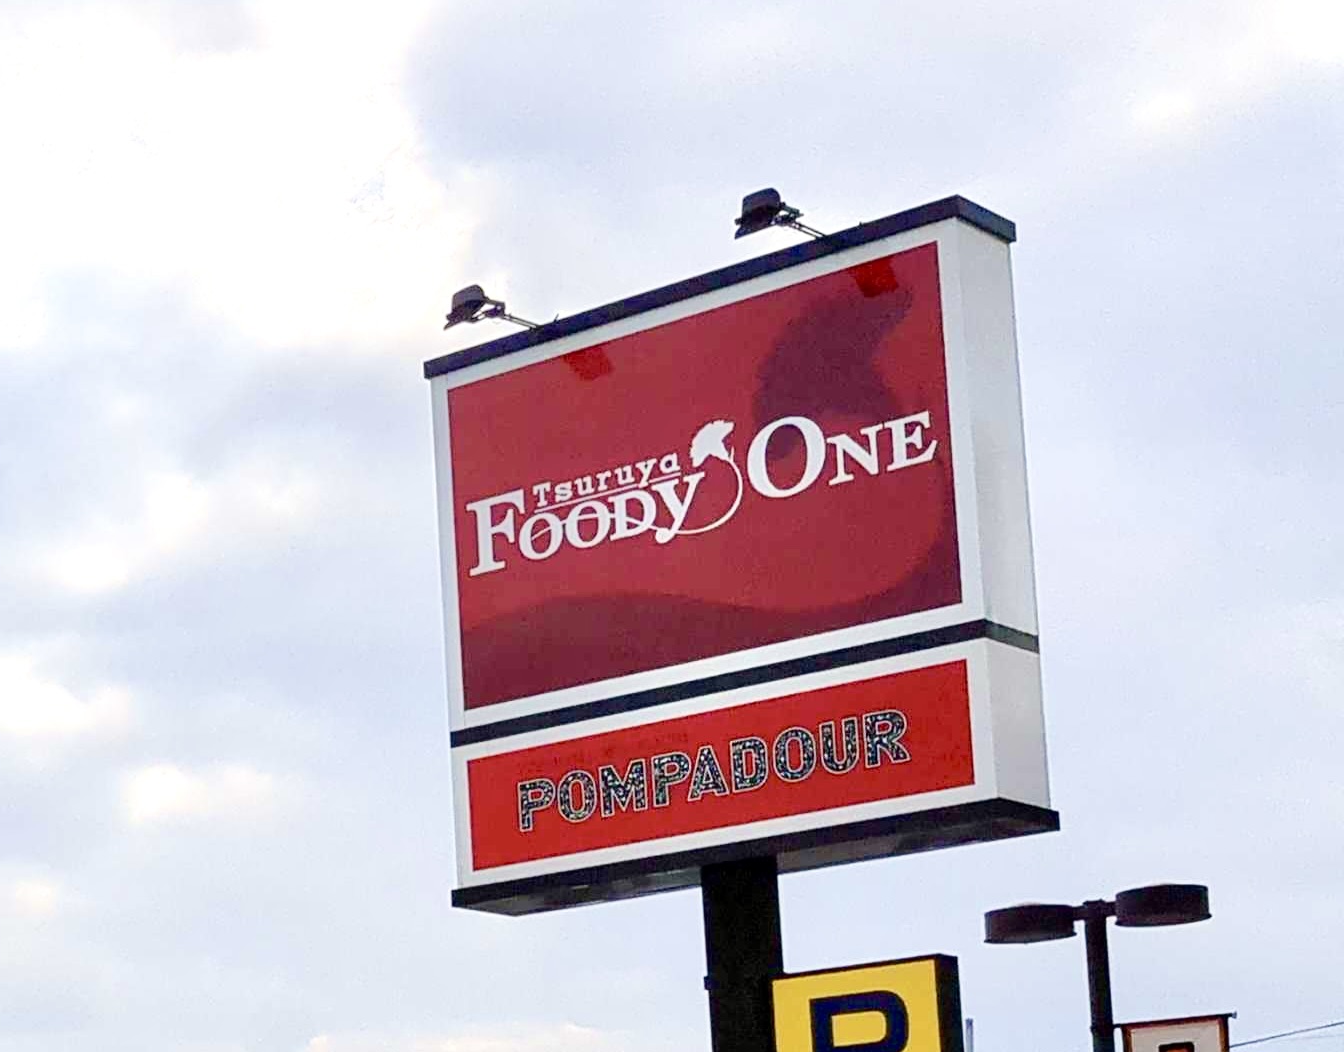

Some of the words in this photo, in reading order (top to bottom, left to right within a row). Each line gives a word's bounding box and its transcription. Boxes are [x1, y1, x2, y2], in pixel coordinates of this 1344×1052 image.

[532, 451, 682, 509] Tsuruya
[746, 409, 938, 500] ONE
[517, 709, 913, 833] POMPADOUR
